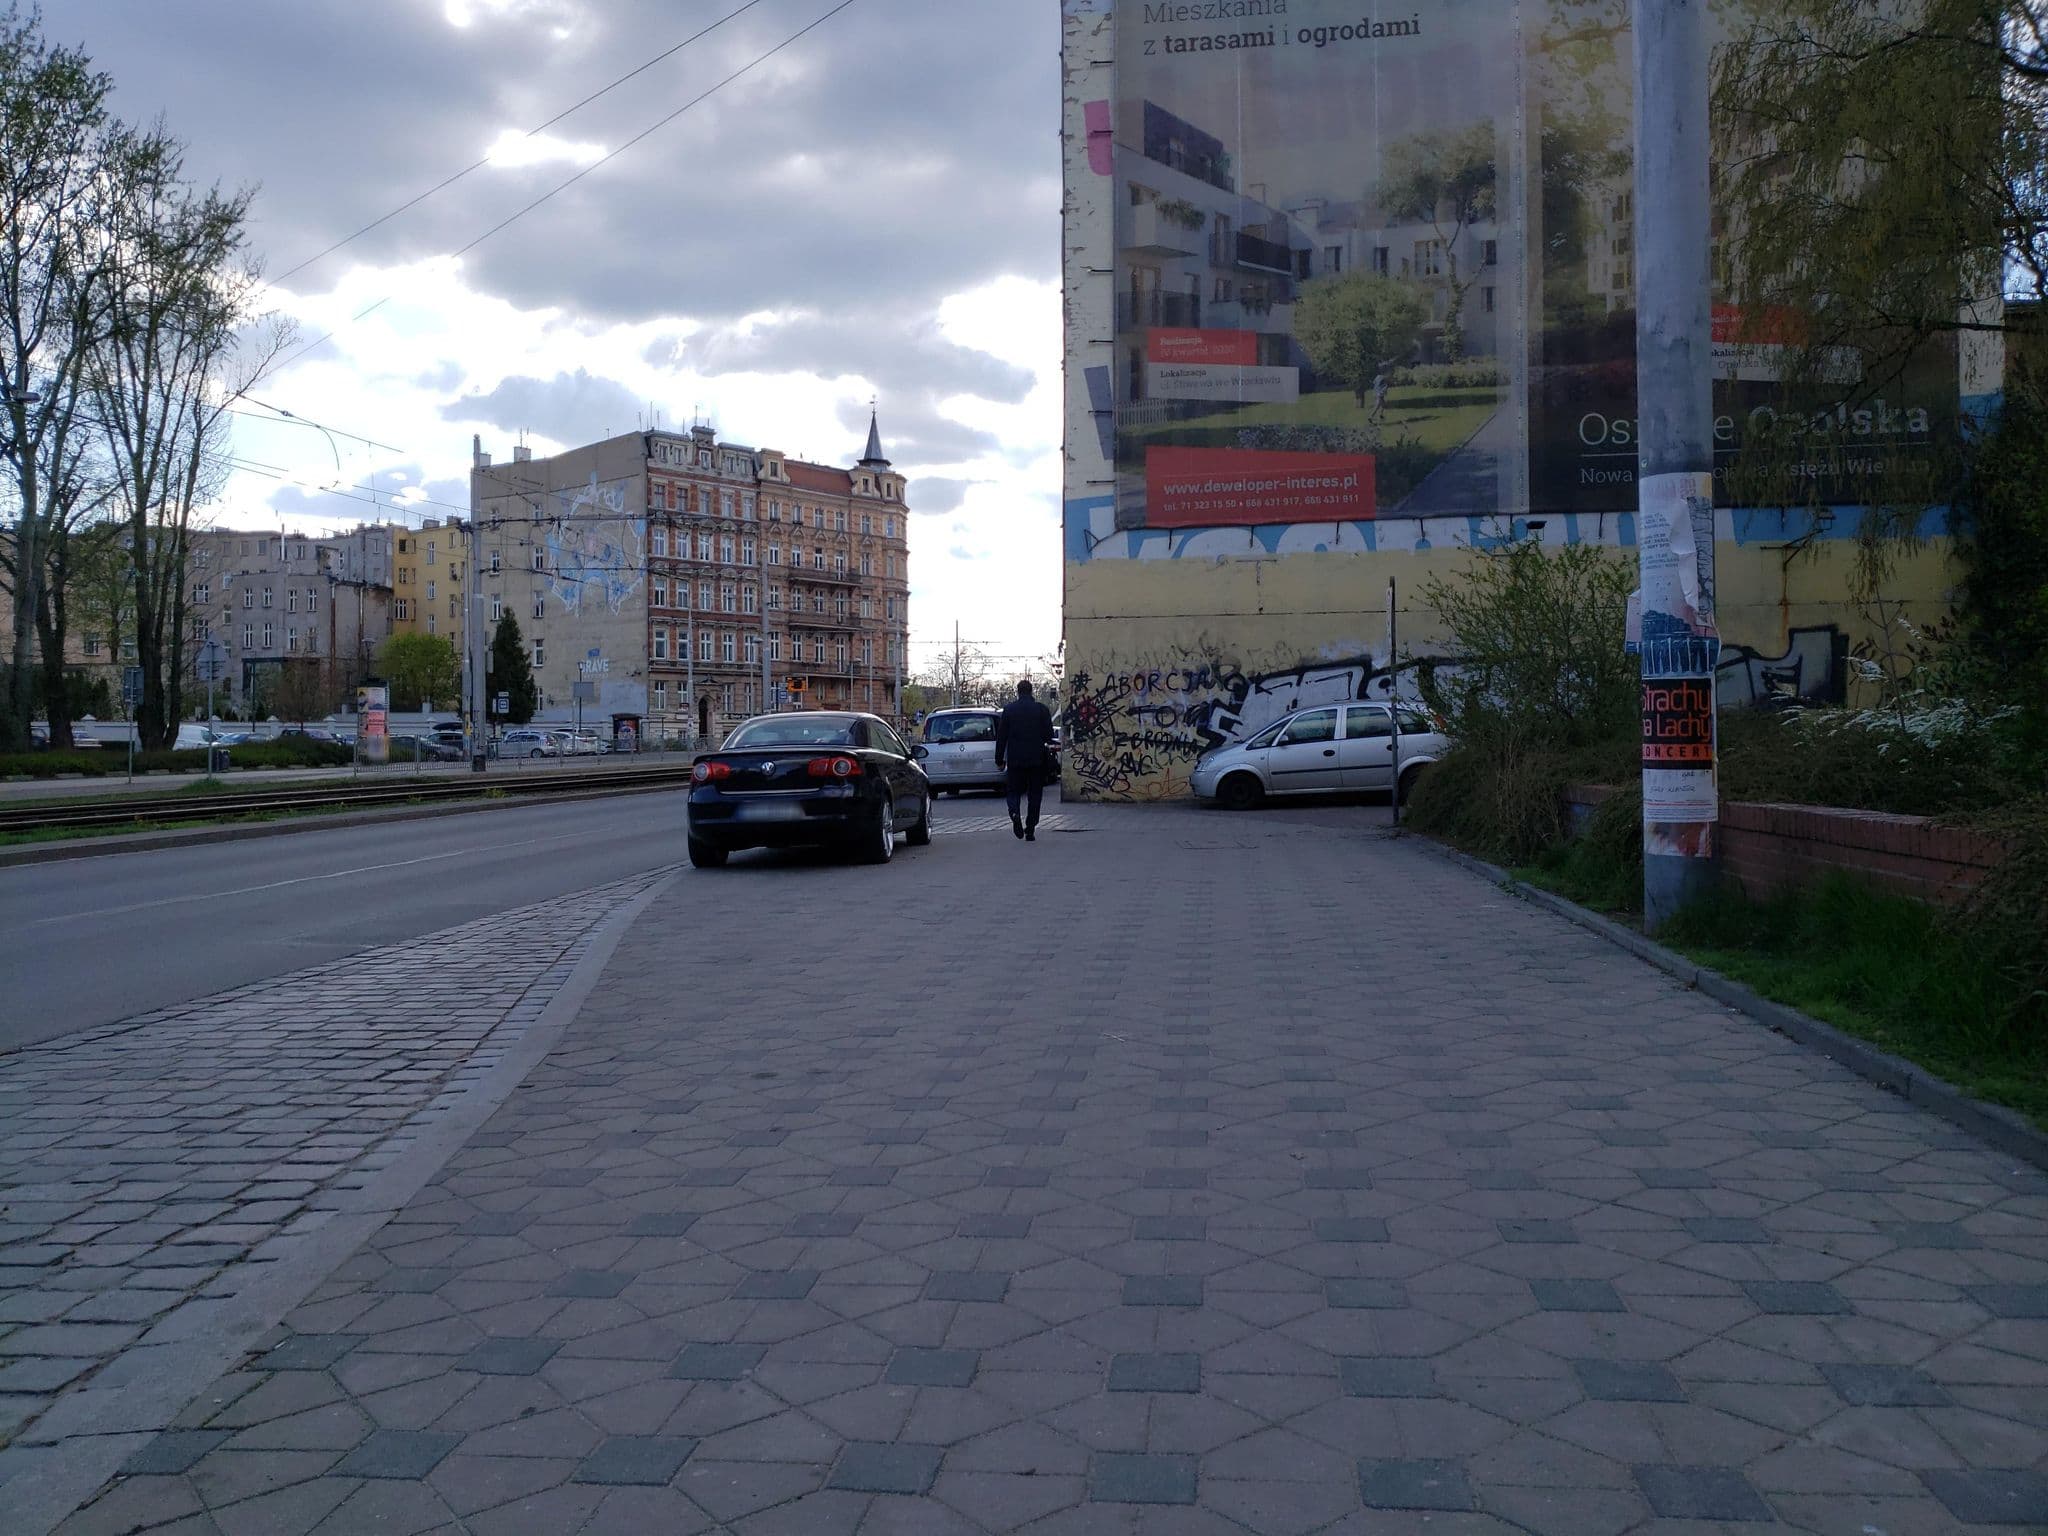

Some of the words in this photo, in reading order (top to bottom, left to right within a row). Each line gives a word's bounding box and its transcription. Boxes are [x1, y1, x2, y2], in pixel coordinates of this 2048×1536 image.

[1144, 0, 1288, 24] Mieszkania
[1143, 39, 1156, 56] z
[1163, 25, 1275, 54] tarasami
[1282, 23, 1290, 45] i
[1297, 13, 1421, 47] ogrodami
[1160, 368, 1207, 379] Lokalizacja
[1163, 472, 1359, 496] www.deweloper-interes.pl
[1579, 468, 1633, 484] Nowa
[1656, 711, 1711, 742] Lachy
[1642, 746, 1710, 758] ONCERT
